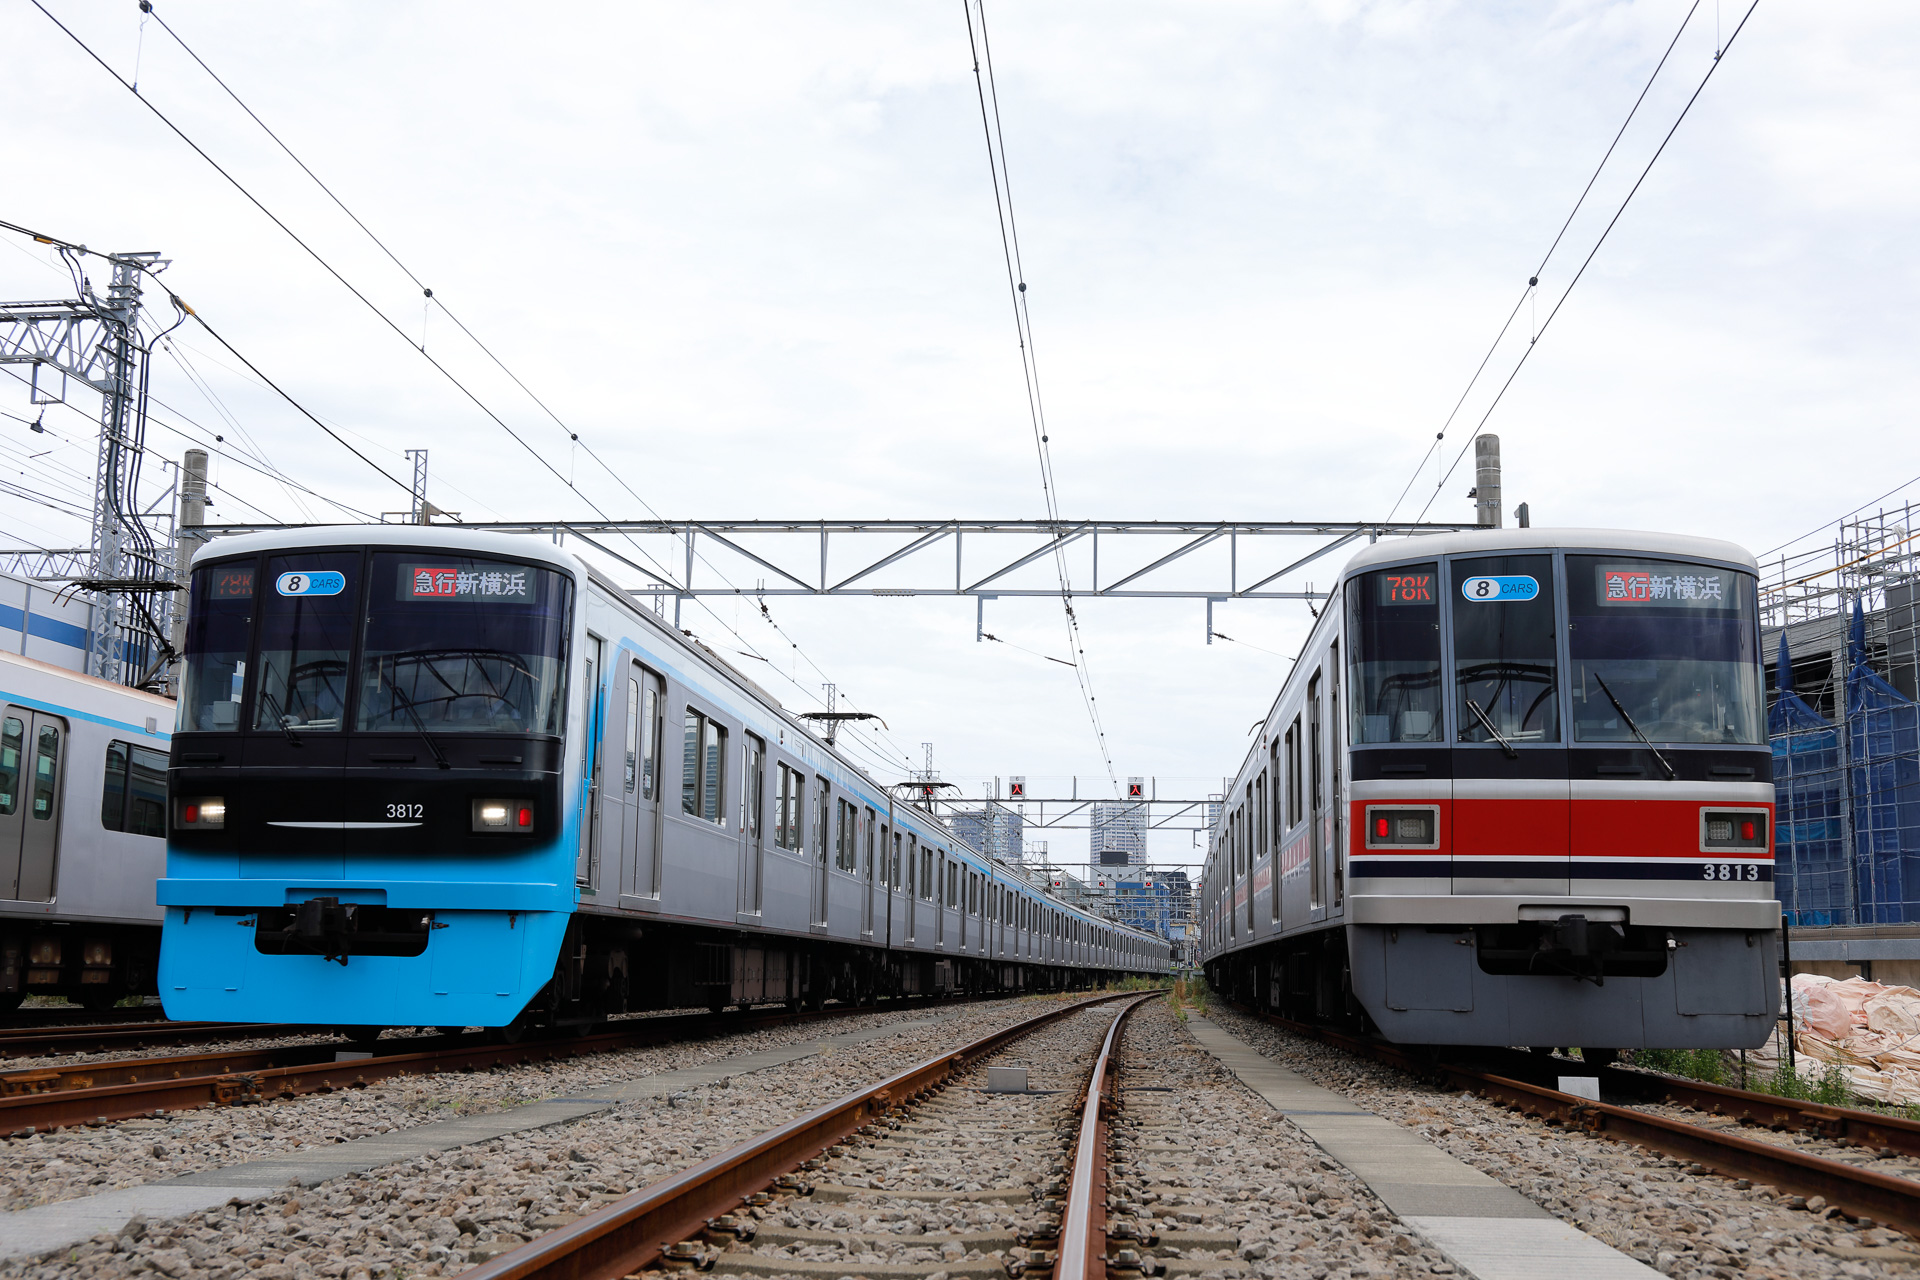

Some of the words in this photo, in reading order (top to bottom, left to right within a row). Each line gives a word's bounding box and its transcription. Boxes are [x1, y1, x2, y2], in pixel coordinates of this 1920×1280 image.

[287, 576, 302, 592] 8
[310, 579, 340, 589] CARS
[1387, 576, 1431, 601] 78K
[1475, 581, 1490, 597] 8
[1501, 583, 1534, 594] CARS
[386, 803, 424, 818] 3812
[1703, 864, 1759, 881] 3813
